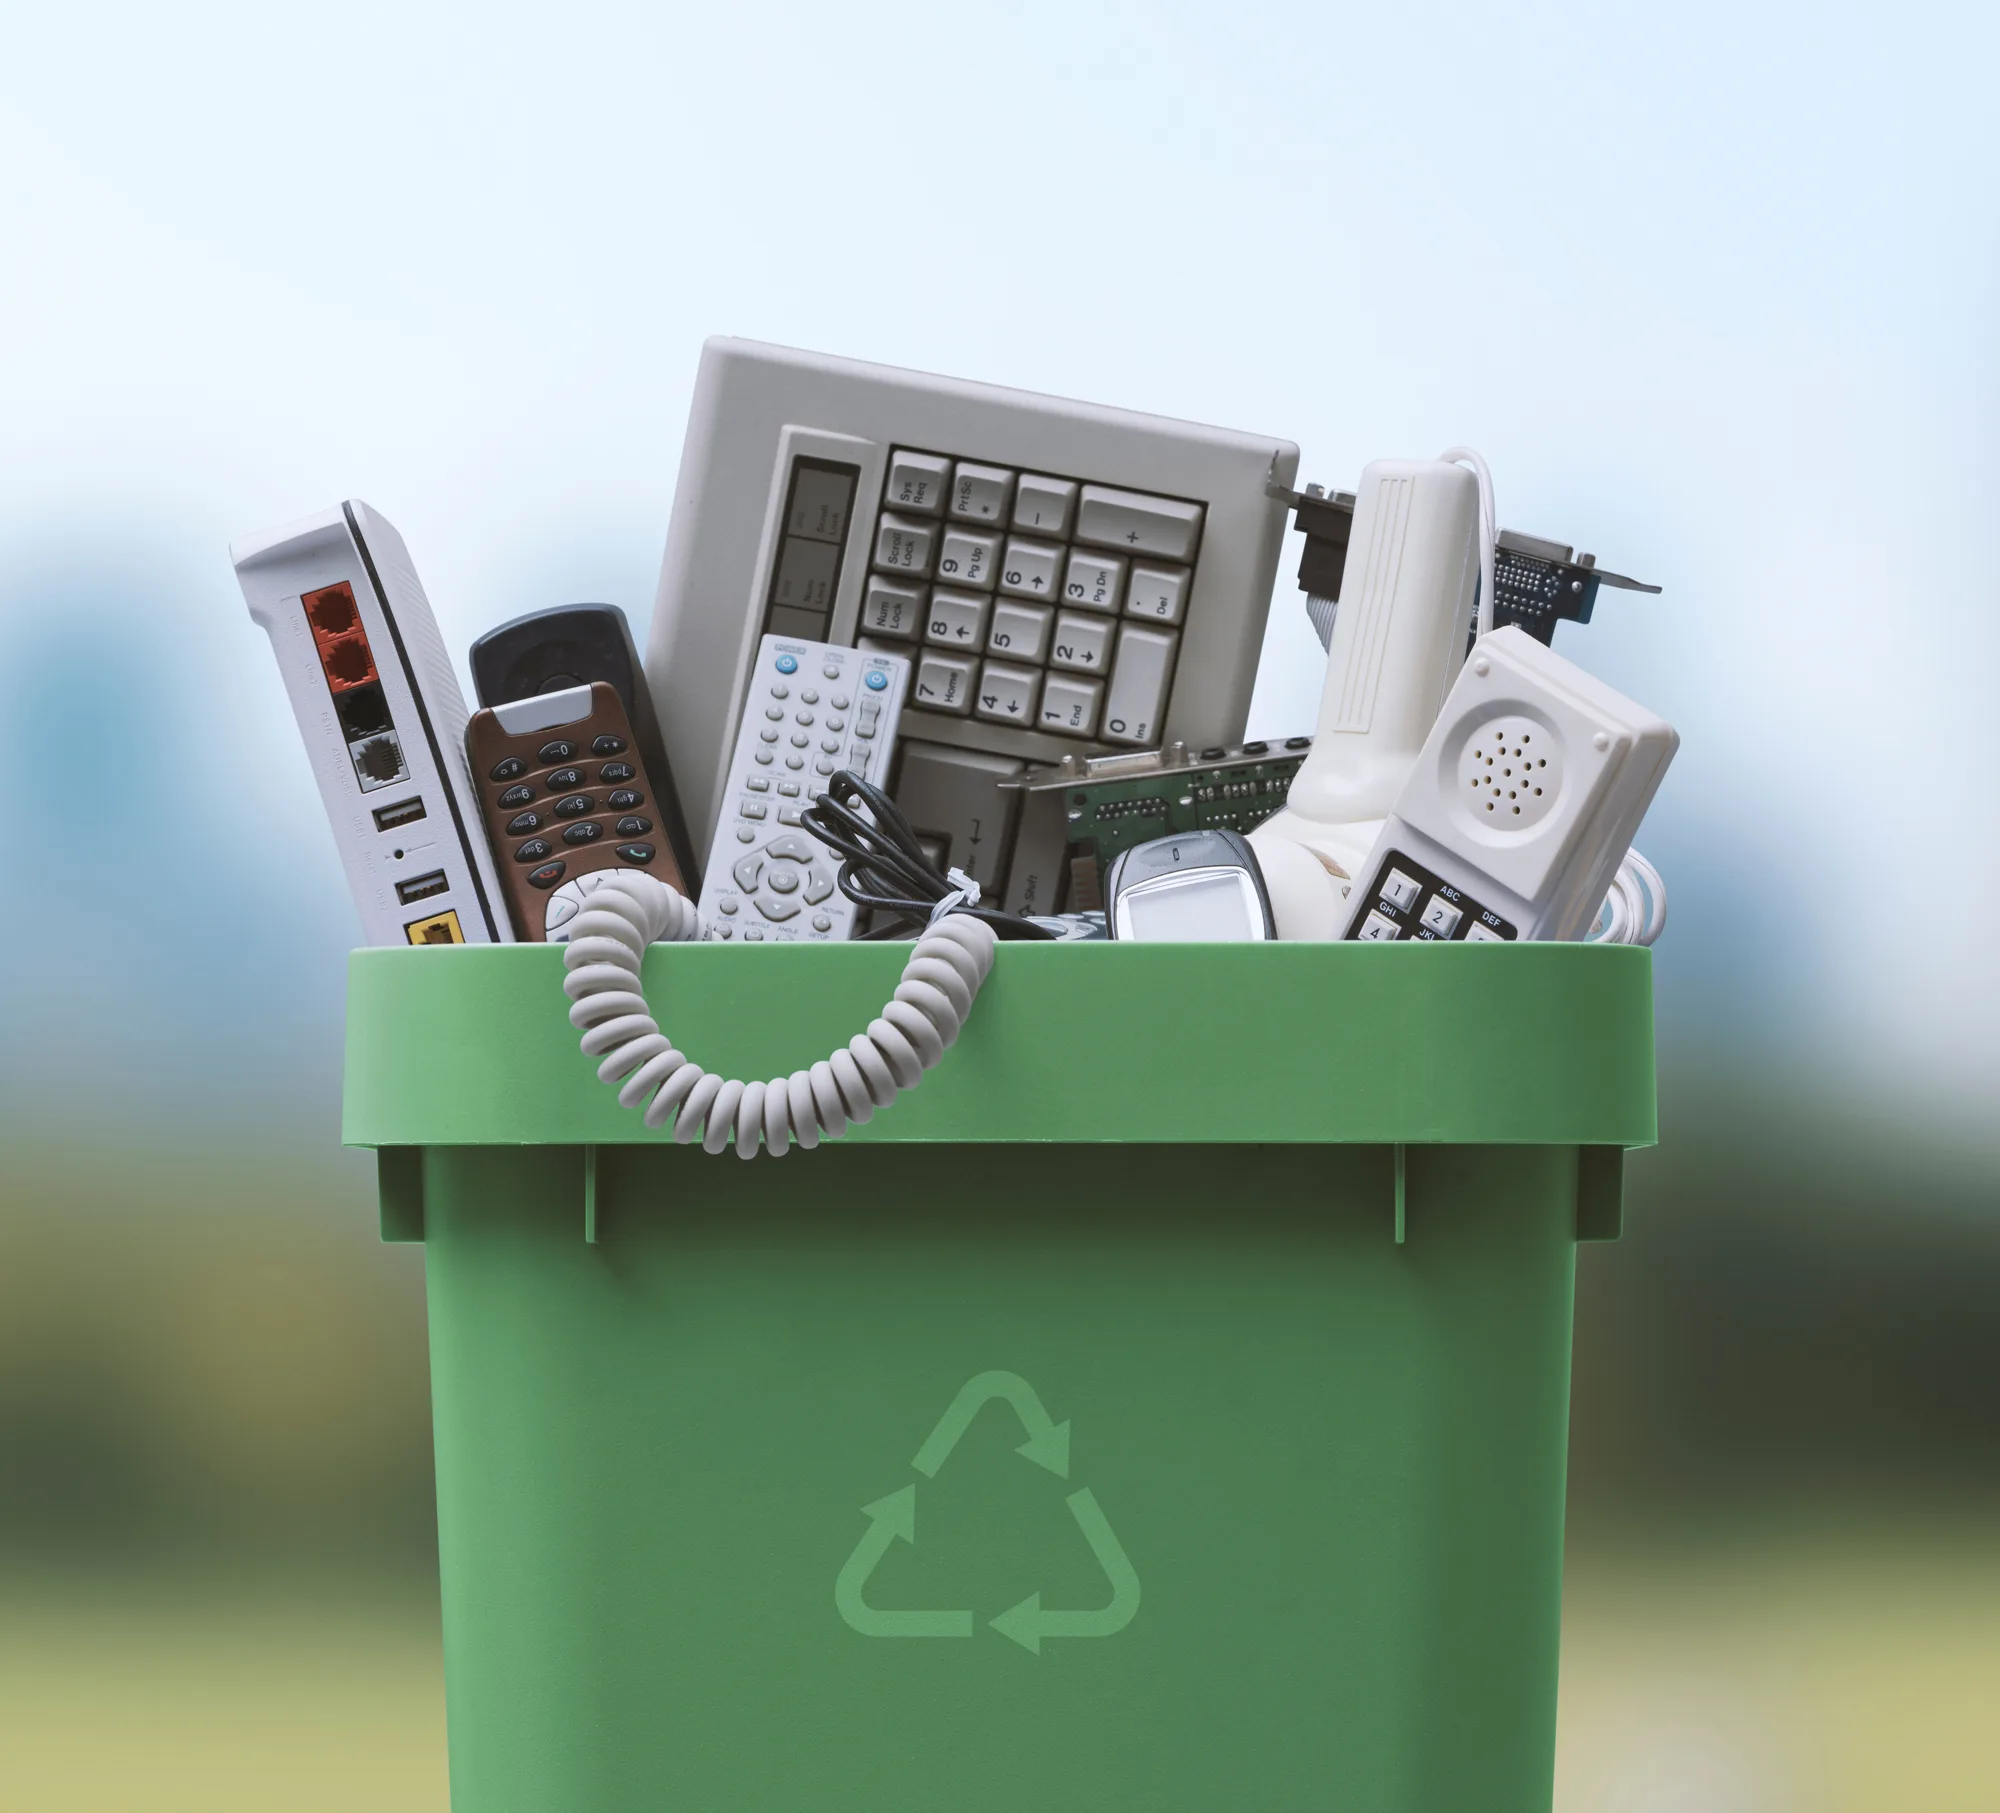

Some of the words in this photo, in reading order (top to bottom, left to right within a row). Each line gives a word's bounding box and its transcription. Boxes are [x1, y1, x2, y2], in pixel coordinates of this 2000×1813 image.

[900, 481, 913, 502] Sys
[913, 481, 928, 504] Req
[958, 480, 972, 512] PrtSc
[888, 532, 902, 565] Scroll
[901, 540, 915, 567] Lock
[971, 547, 984, 562] Up
[942, 558, 959, 573] 9
[968, 564, 981, 578] Pg
[1005, 571, 1022, 586] 6
[1097, 571, 1108, 587] Dn
[1068, 583, 1085, 598] 3
[1094, 588, 1106, 602] Pg
[876, 601, 890, 627] Num
[1157, 596, 1169, 616] Del
[889, 602, 903, 629] Lock
[931, 621, 948, 635] 8
[994, 633, 1011, 647] 5
[1056, 644, 1074, 660] 2
[918, 683, 935, 698] 7
[944, 671, 959, 703] Home
[982, 694, 999, 709] 4
[1045, 710, 1061, 721] 1
[1070, 705, 1083, 727] End
[1109, 718, 1126, 734] 0
[1135, 722, 1147, 740] Ins
[966, 854, 977, 876] nter
[1024, 875, 1039, 901] Shift
[1394, 884, 1402, 896] 1
[1440, 885, 1461, 902] ABC
[1379, 901, 1397, 918] GHI
[1432, 911, 1443, 924] 2
[1482, 911, 1502, 928] DEF
[1370, 927, 1380, 939] 4
